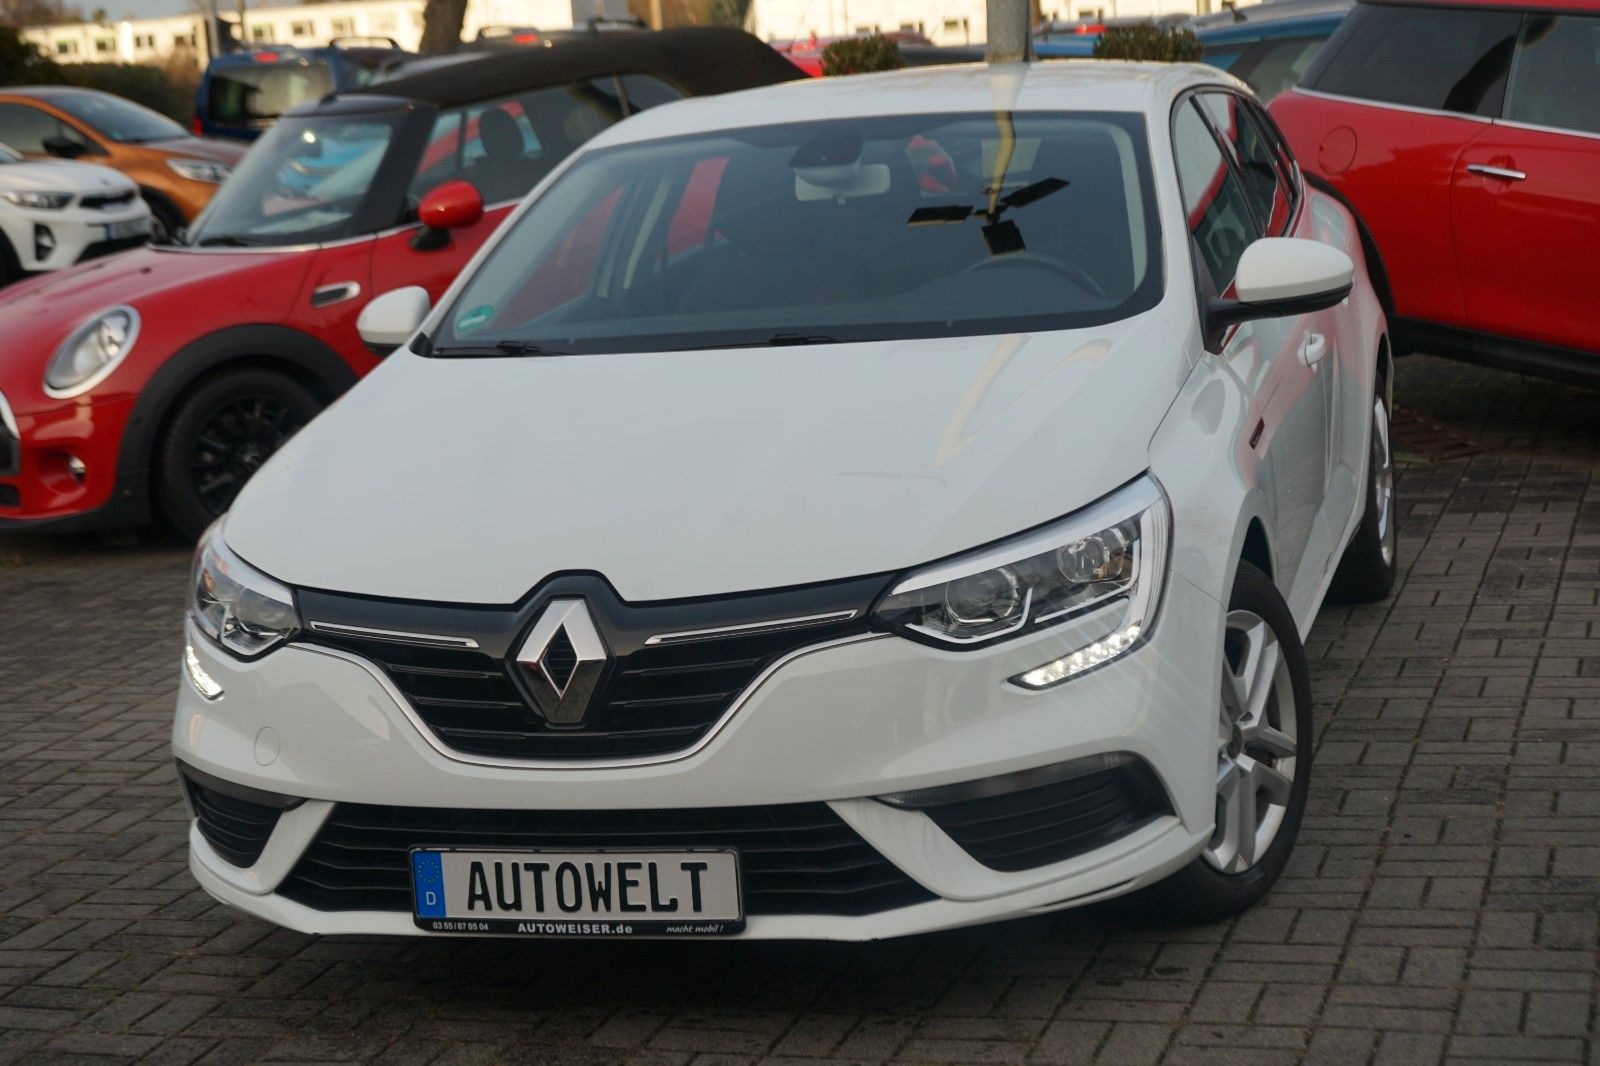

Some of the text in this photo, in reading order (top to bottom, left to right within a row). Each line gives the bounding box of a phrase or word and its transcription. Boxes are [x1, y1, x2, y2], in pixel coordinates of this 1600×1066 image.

[467, 861, 707, 912] AUTOWELT
[425, 891, 437, 906] D
[517, 922, 633, 934] AUTOWEISER.de
[666, 925, 693, 933] macht
